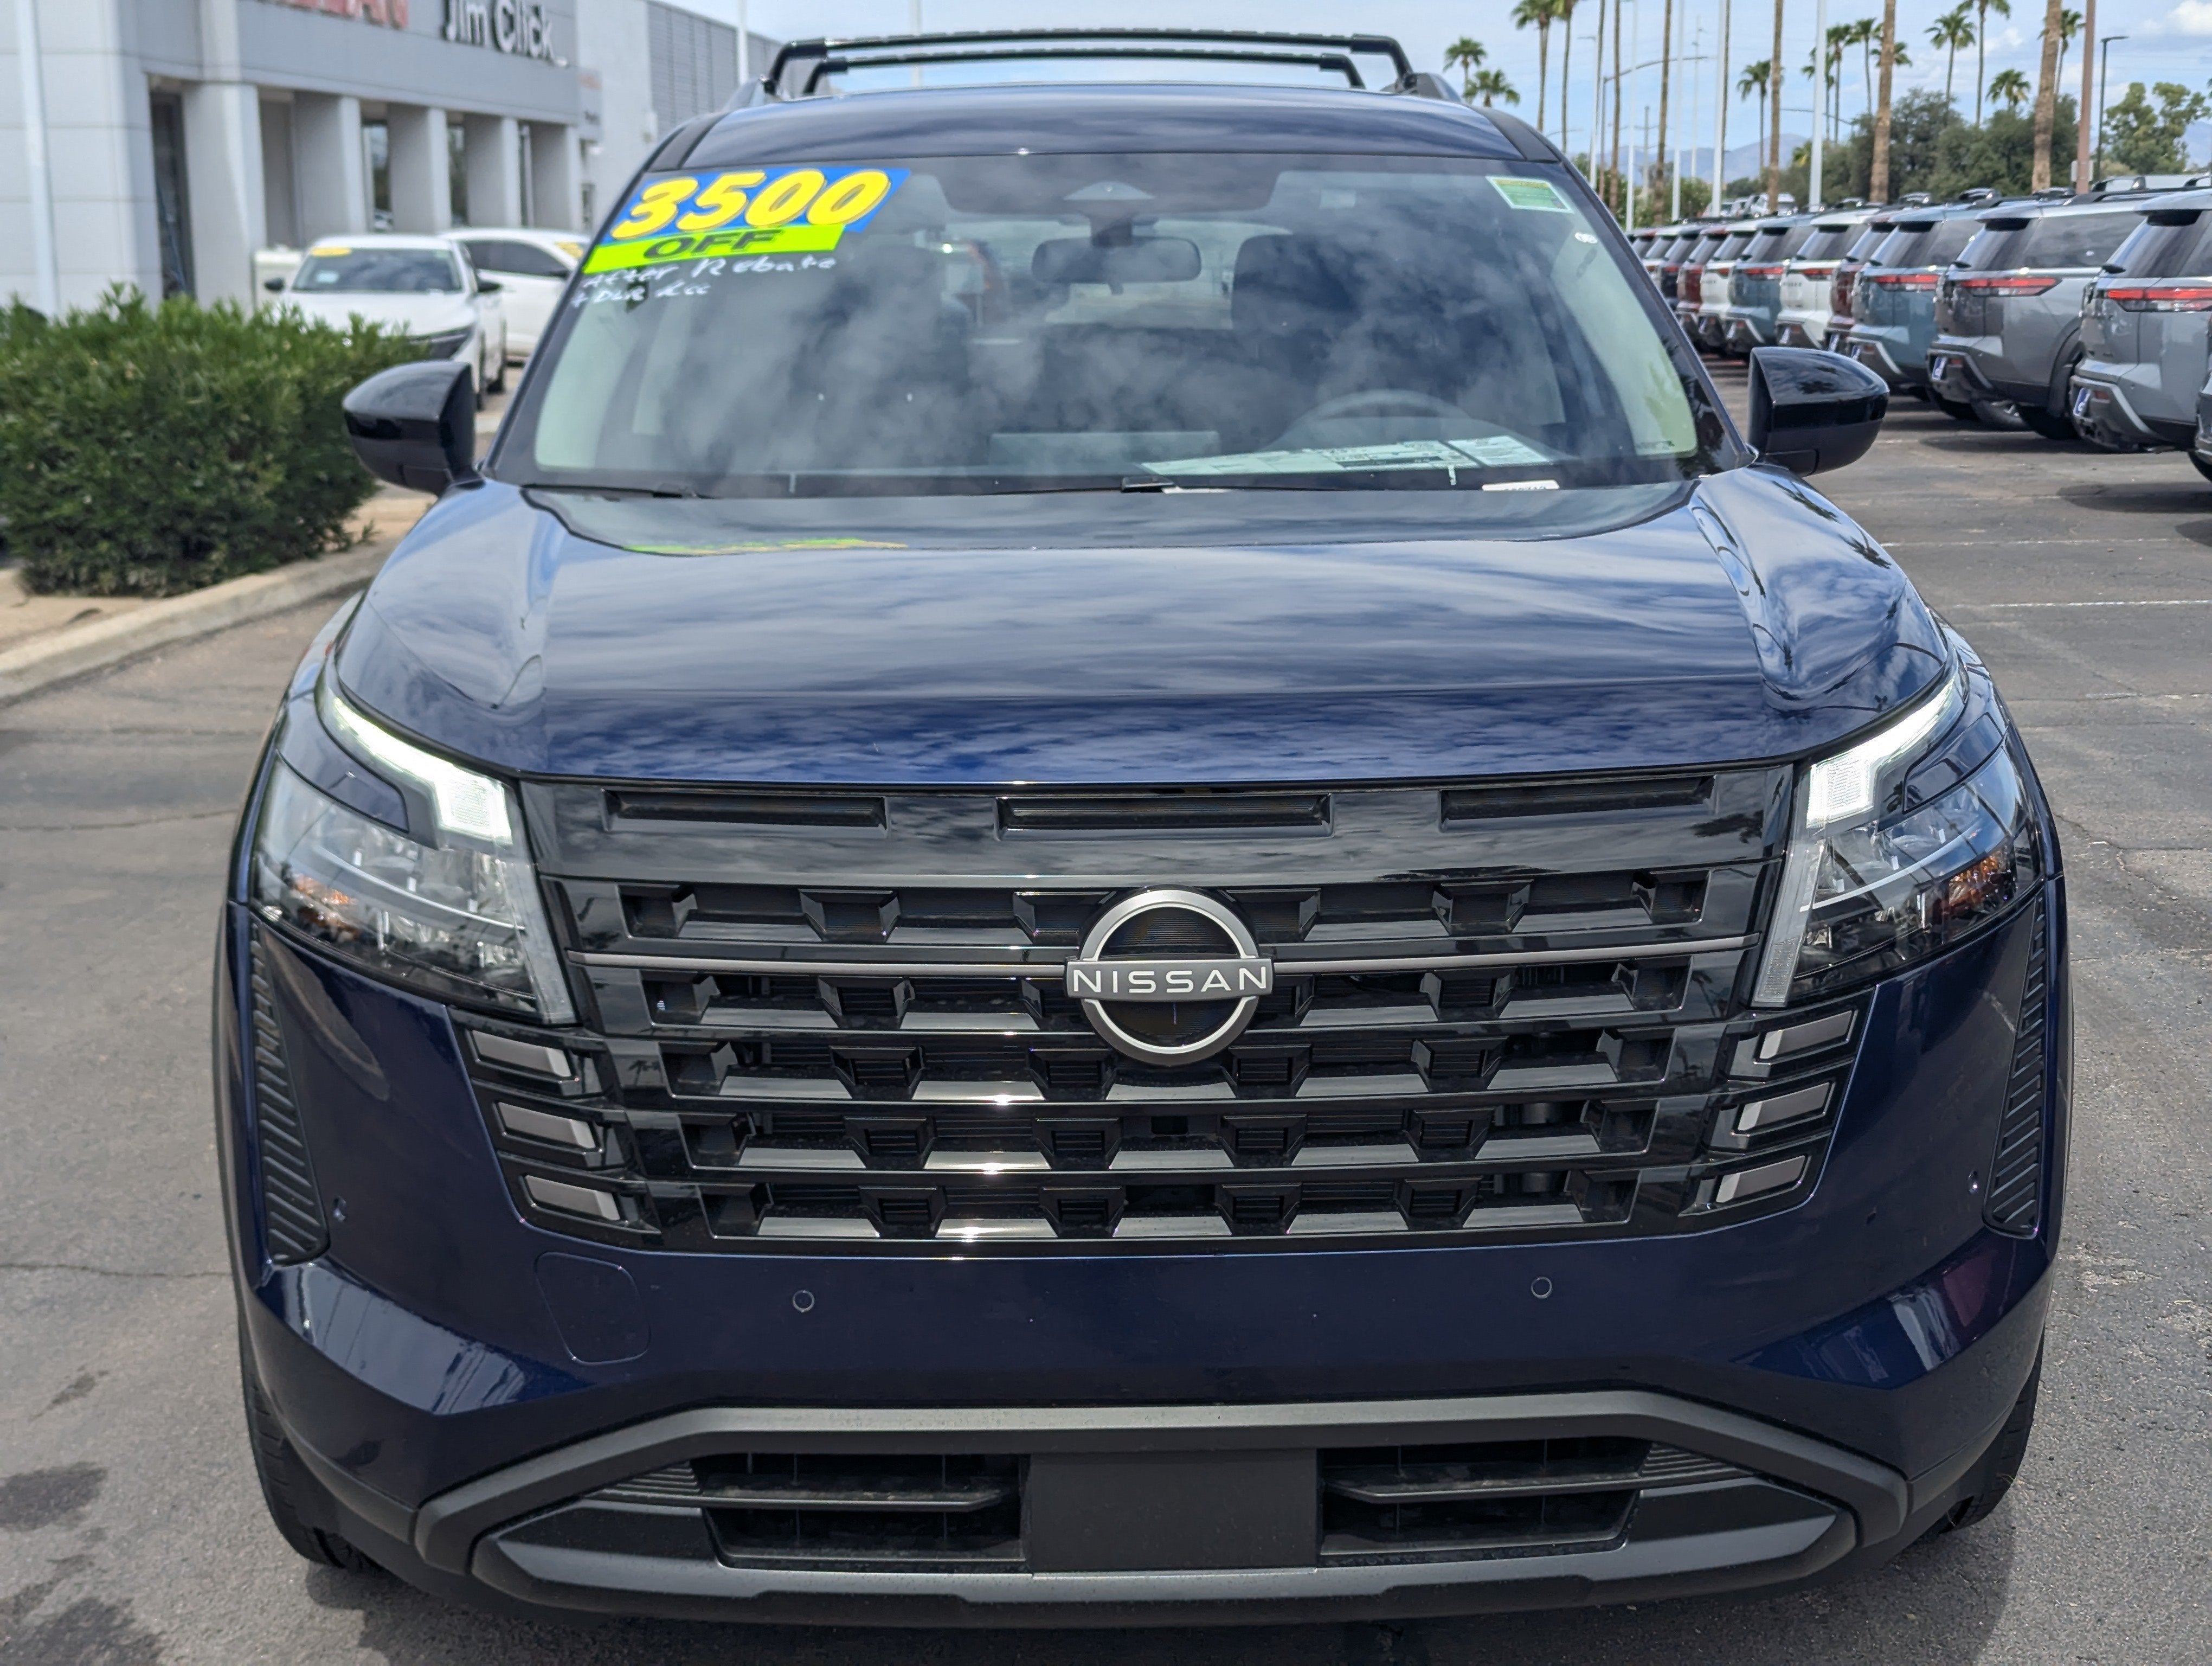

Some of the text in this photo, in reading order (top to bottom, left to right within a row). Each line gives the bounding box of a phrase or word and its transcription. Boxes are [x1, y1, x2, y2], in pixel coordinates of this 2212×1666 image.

[610, 170, 891, 240] 3500
[643, 229, 785, 259] OFF
[691, 254, 837, 278] Rebate
[1073, 966, 1267, 994] NISSAN
